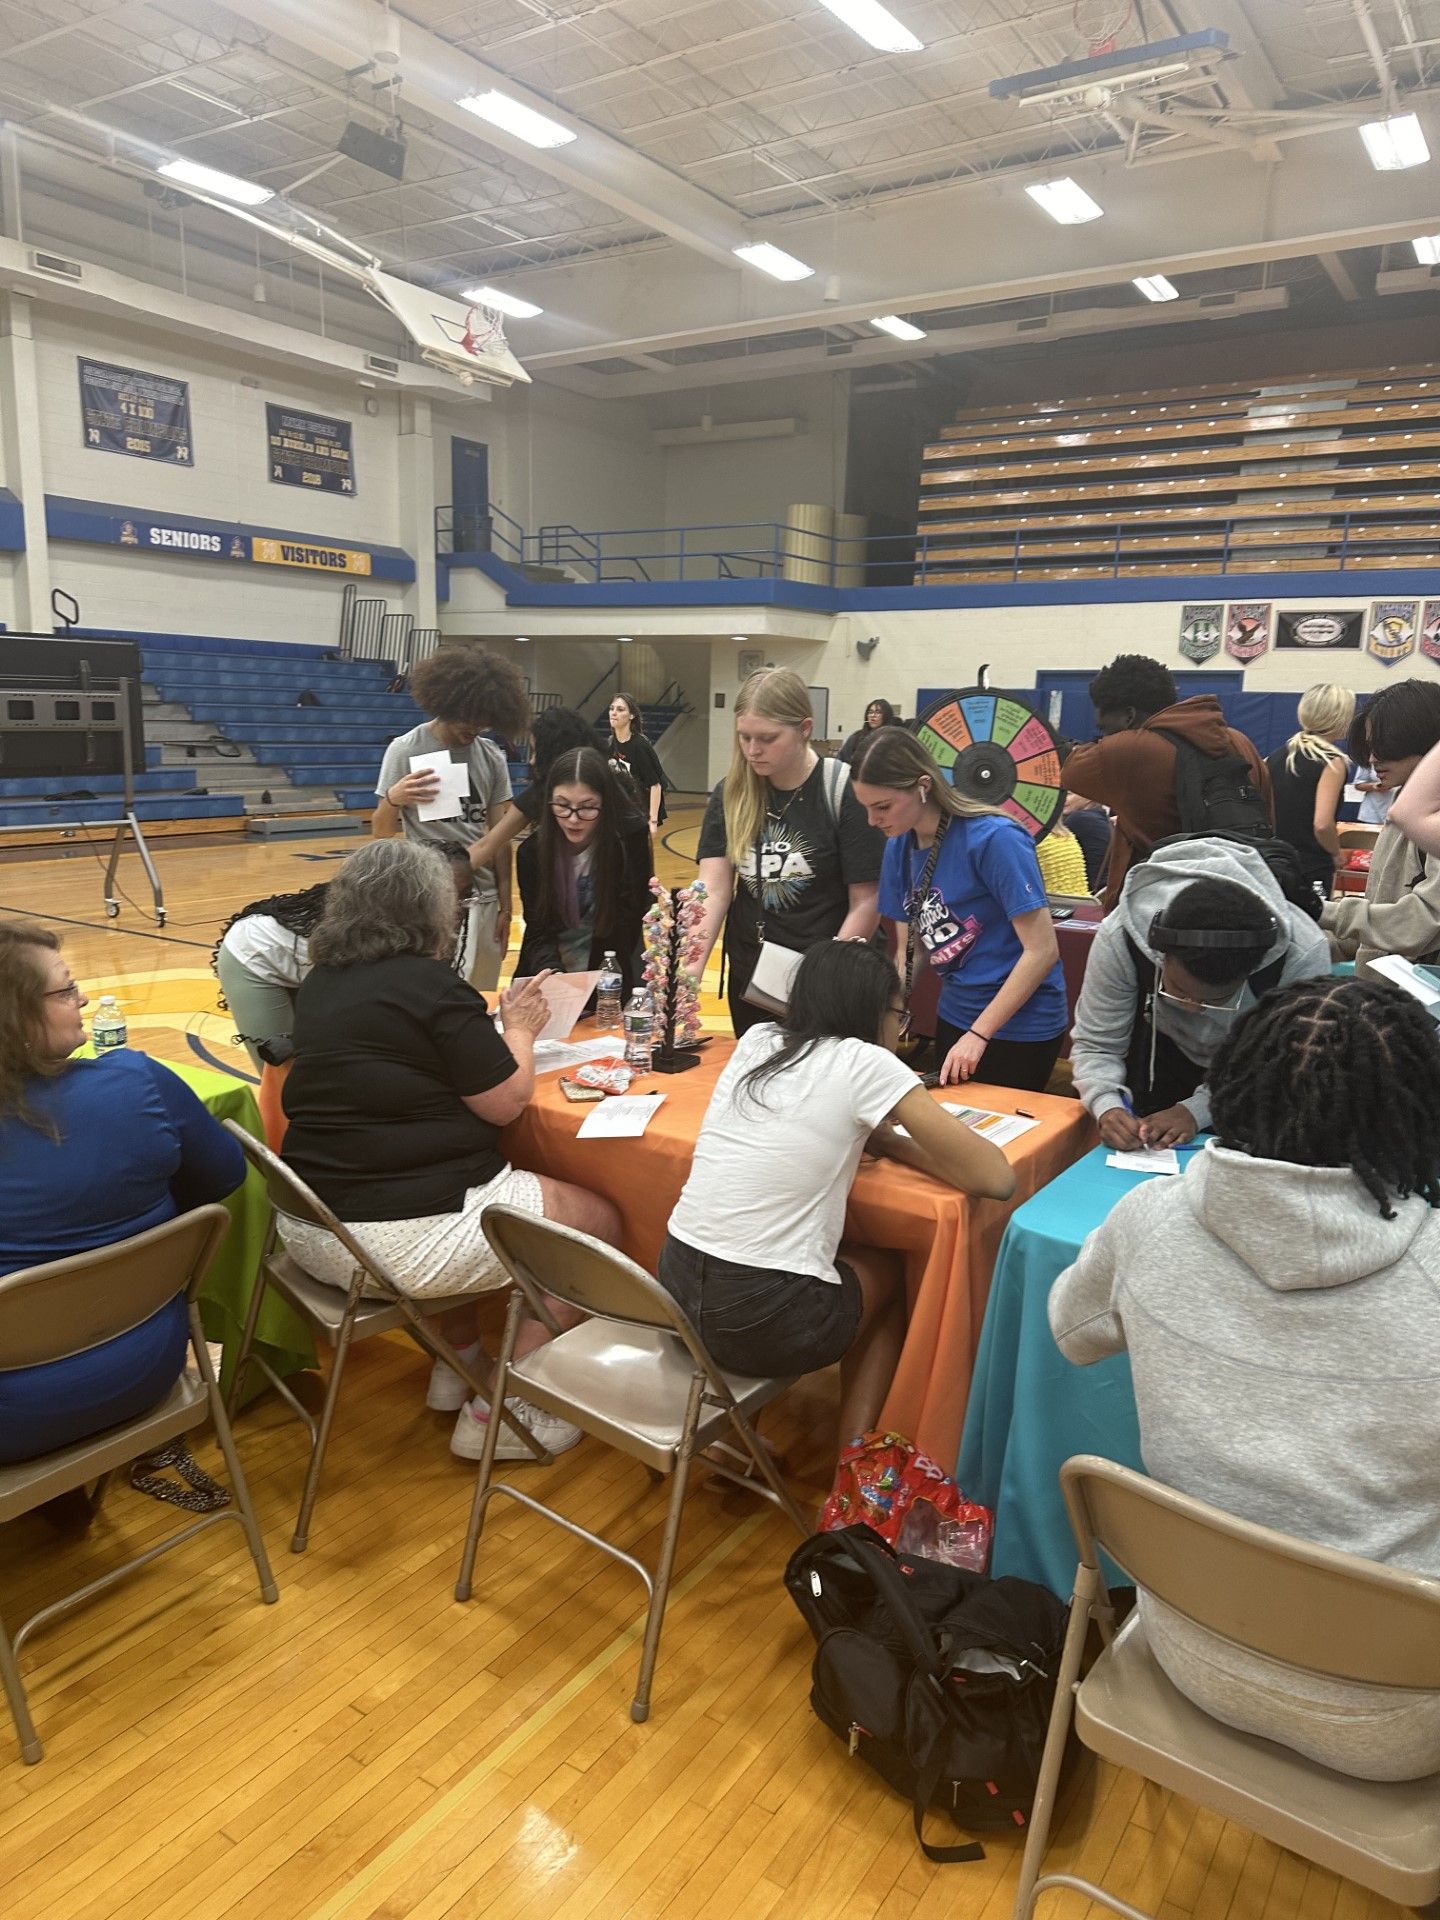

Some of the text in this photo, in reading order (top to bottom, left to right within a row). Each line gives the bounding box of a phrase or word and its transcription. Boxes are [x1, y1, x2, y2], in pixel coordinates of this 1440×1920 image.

[149, 527, 222, 553] SENIORS
[280, 544, 347, 569] VISITORS
[929, 933, 977, 966] MITS
